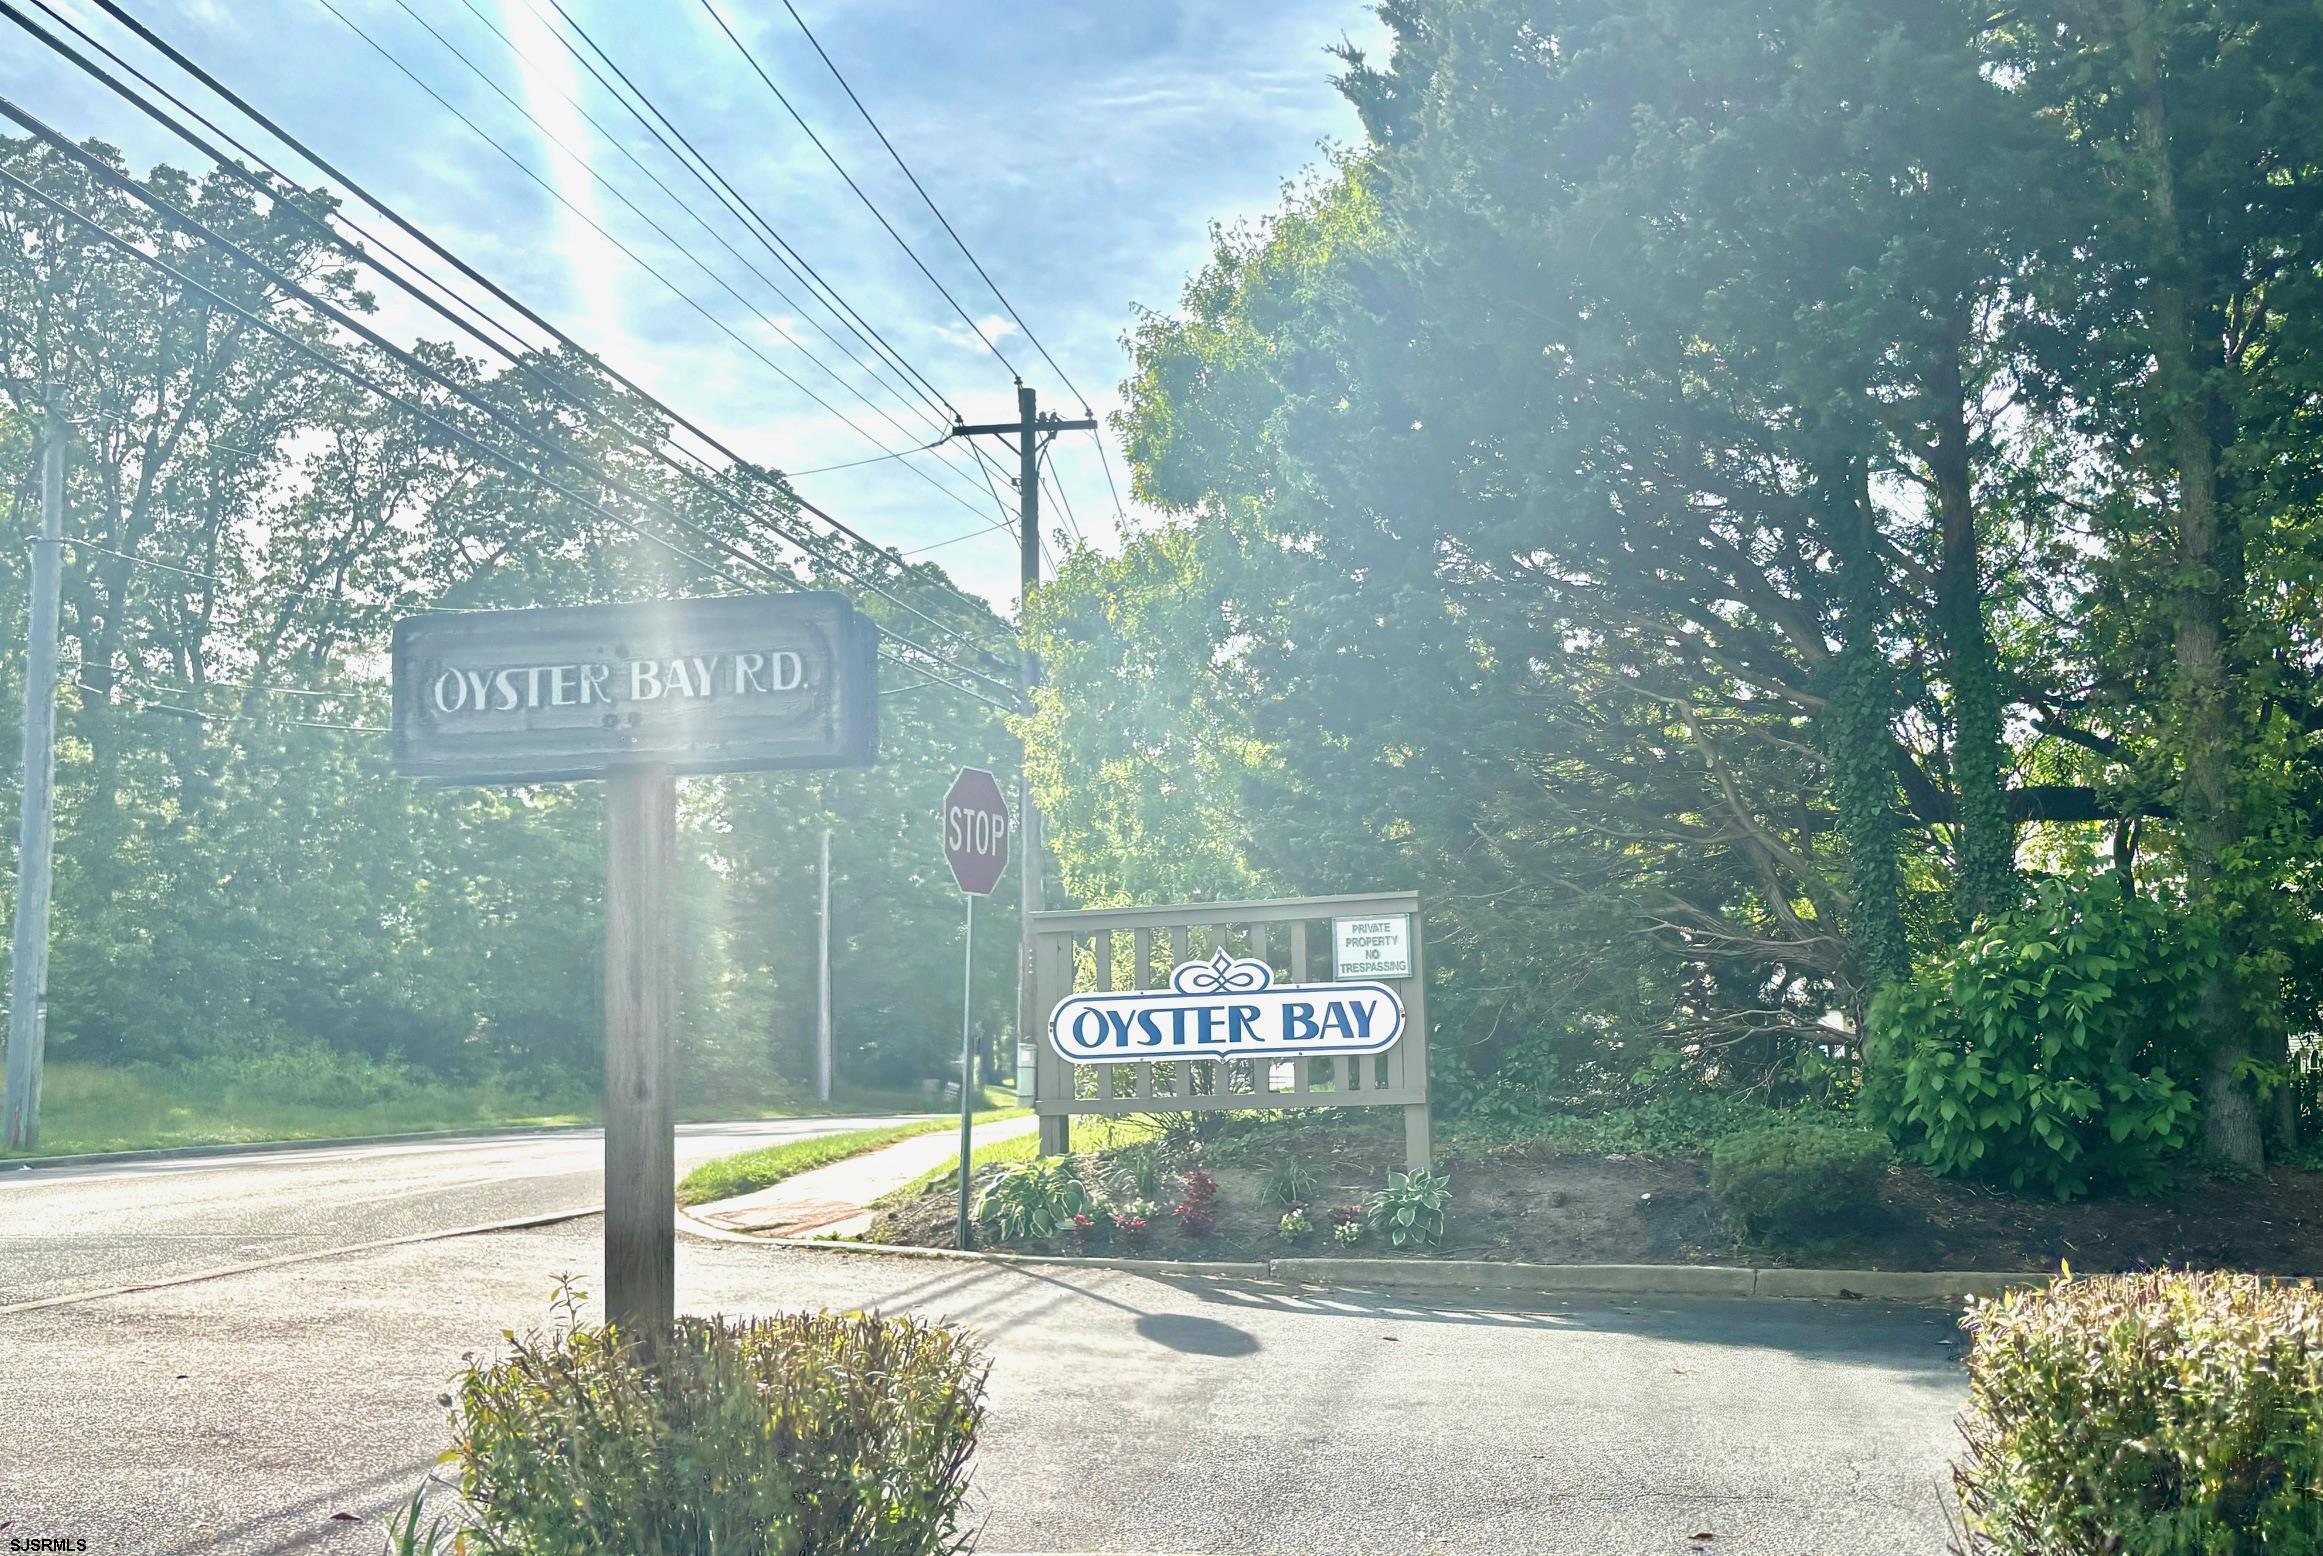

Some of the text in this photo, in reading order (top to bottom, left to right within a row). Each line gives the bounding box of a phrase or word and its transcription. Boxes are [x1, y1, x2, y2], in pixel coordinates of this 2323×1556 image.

[434, 651, 809, 713] OYSTER BAY RD.
[949, 806, 1005, 857] STOP
[1351, 922, 1391, 934] PRIVATE
[1345, 935, 1399, 948] PROPERTY
[1365, 949, 1380, 960] NO
[1339, 960, 1407, 973] TRESPASSING
[1072, 999, 1378, 1049] OYSTER BAY
